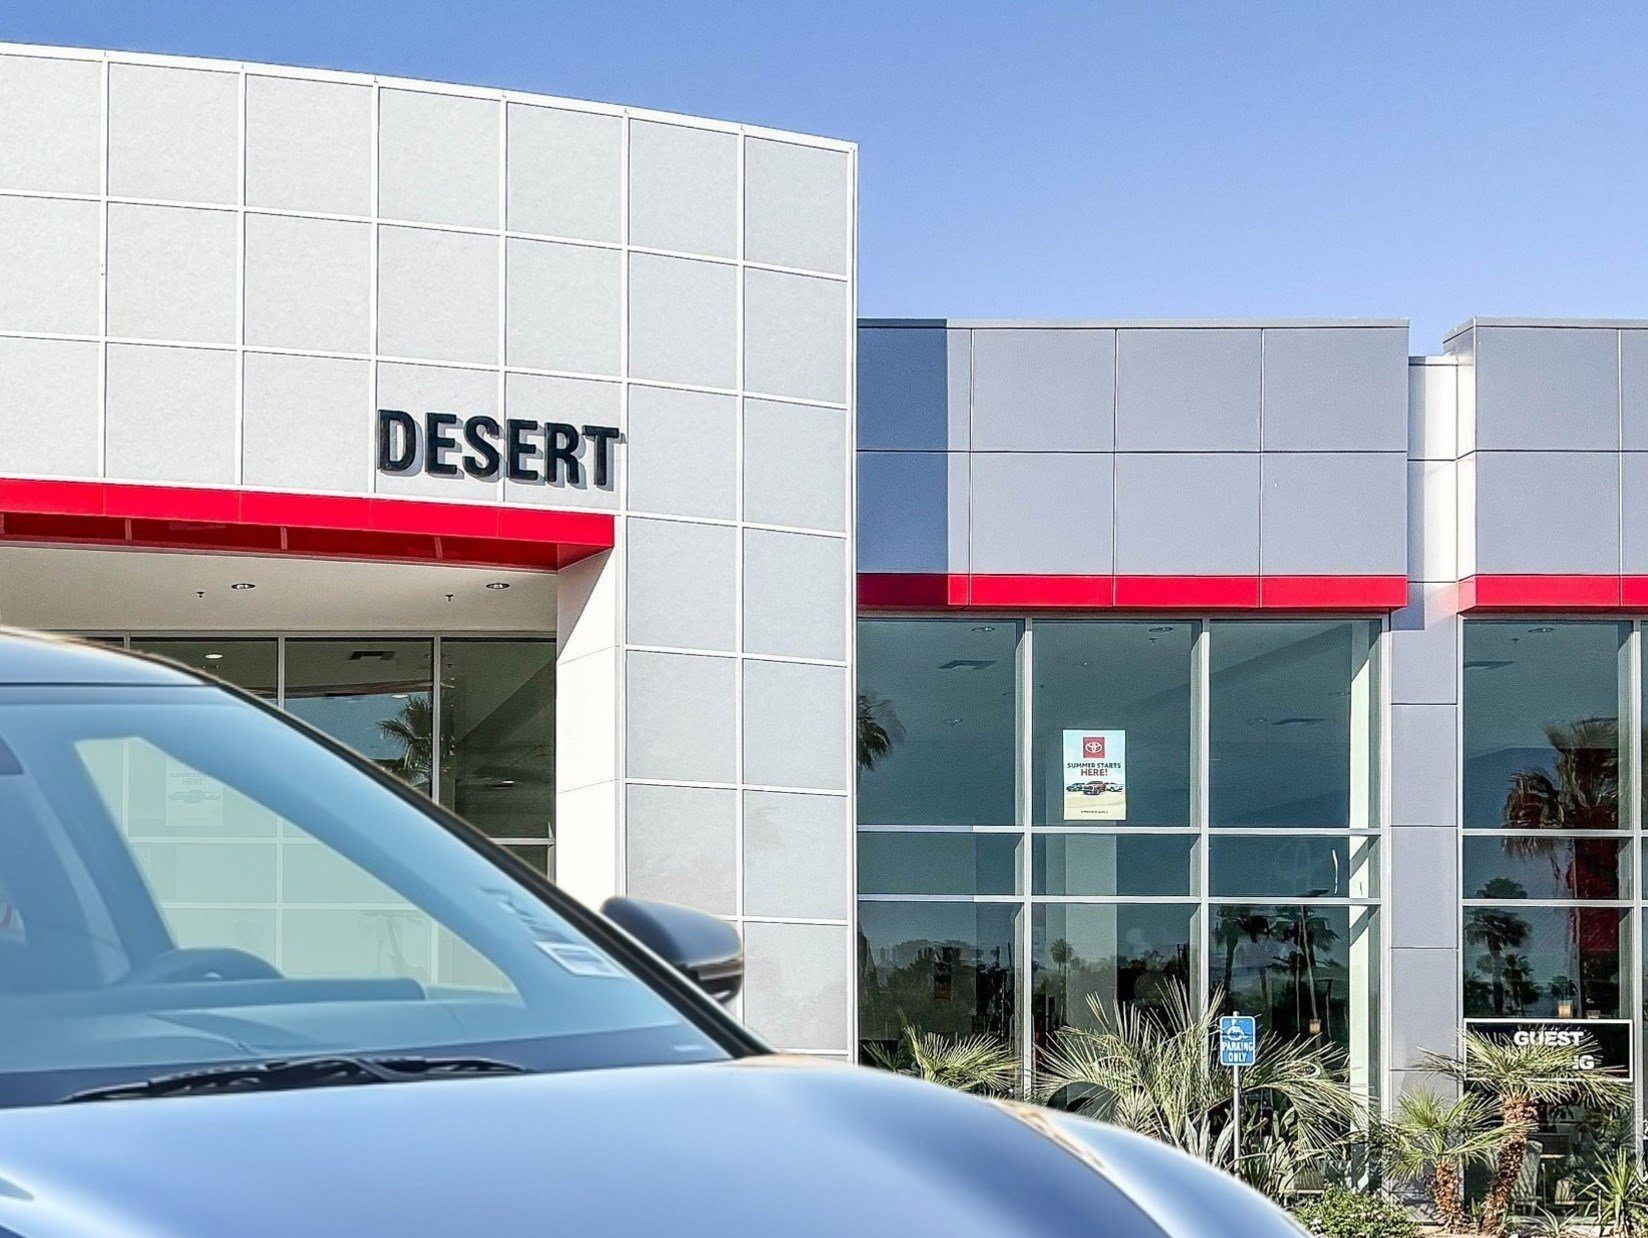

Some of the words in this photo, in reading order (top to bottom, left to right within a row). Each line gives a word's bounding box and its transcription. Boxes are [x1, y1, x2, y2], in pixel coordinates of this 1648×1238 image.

[377, 409, 620, 486] DESERT
[1514, 1031, 1584, 1046] GUEST
[1222, 1041, 1253, 1051] PARKING
[1228, 1052, 1247, 1062] ONLY
